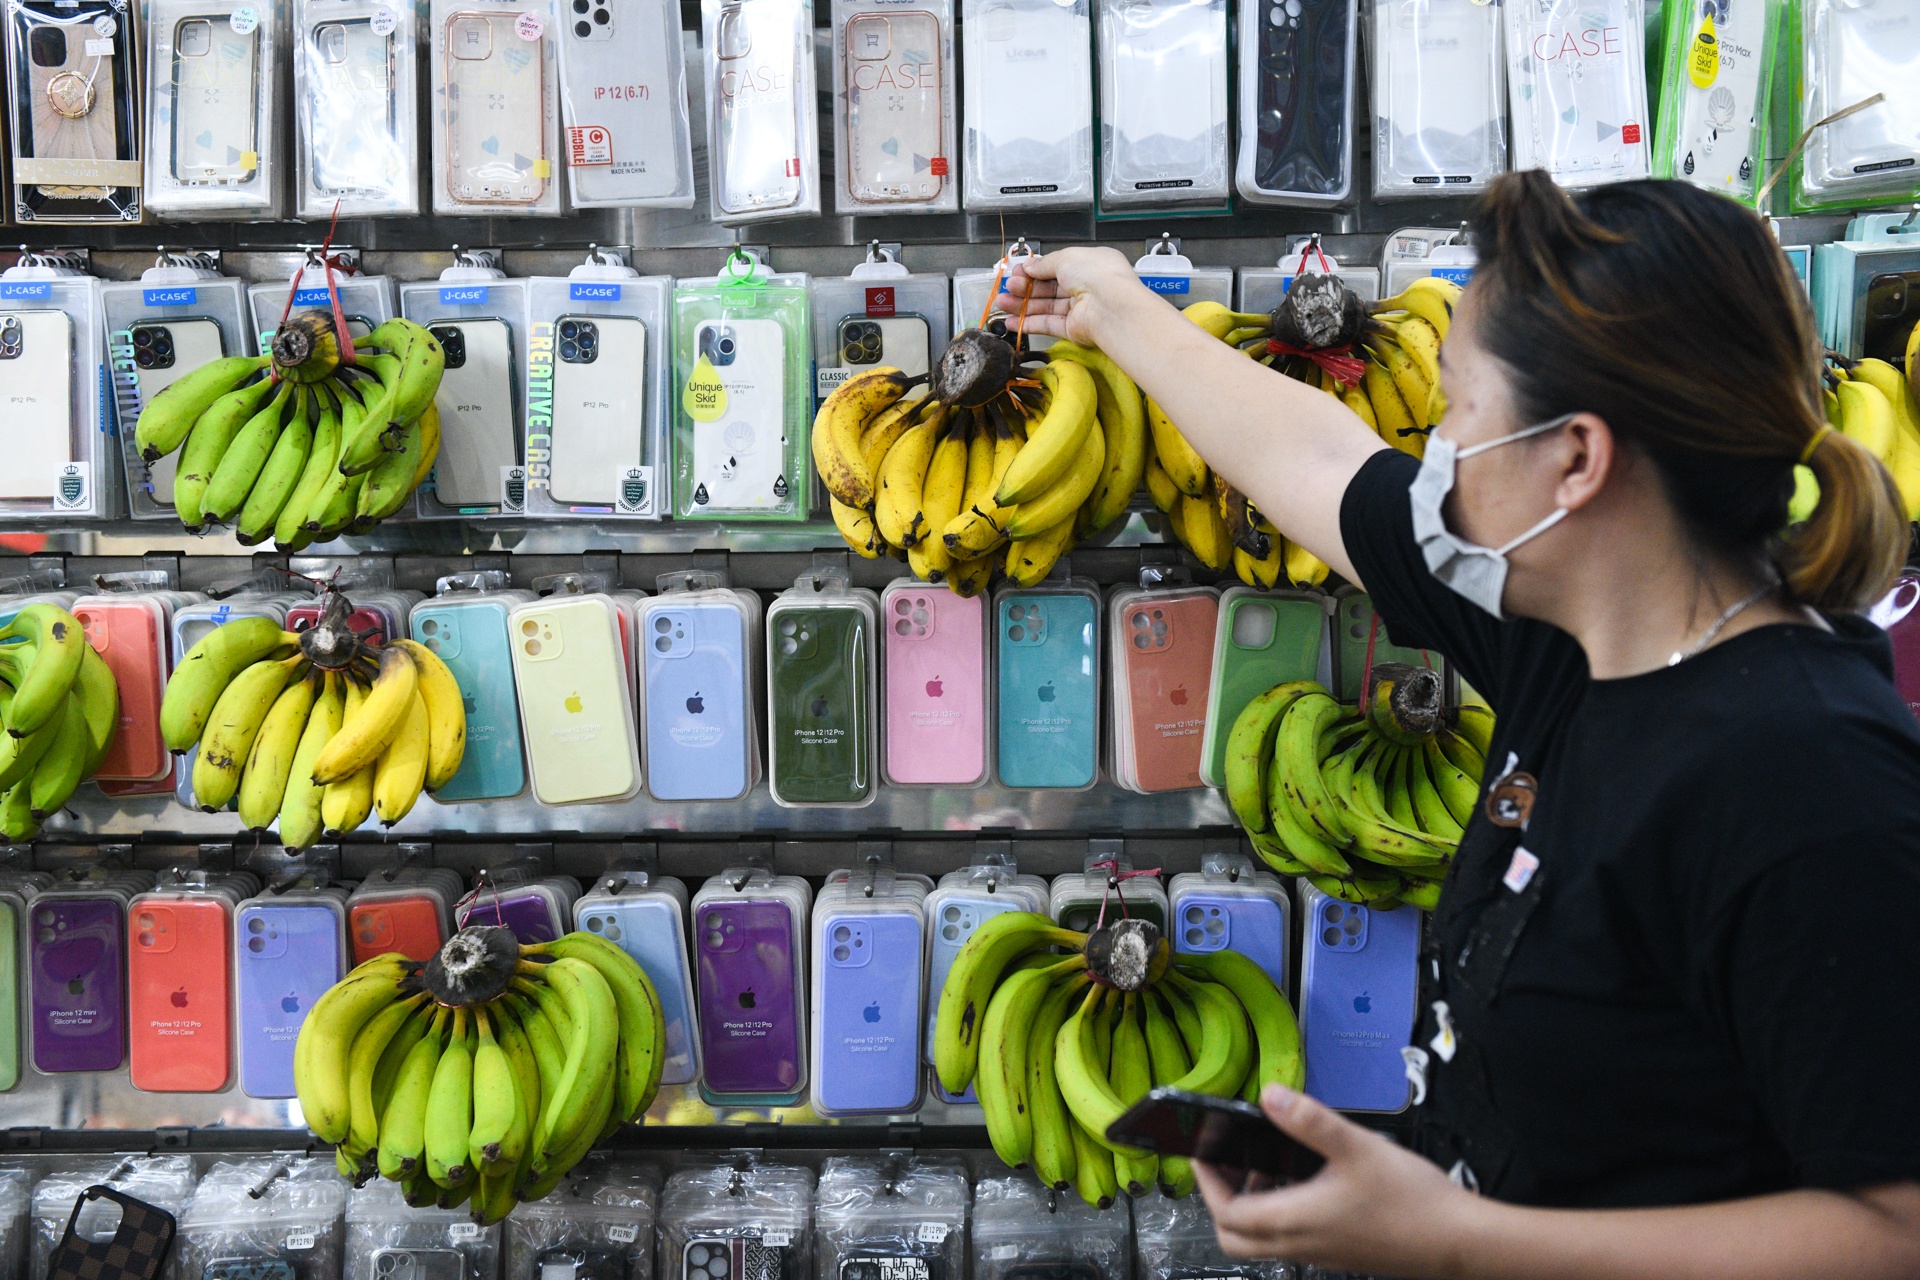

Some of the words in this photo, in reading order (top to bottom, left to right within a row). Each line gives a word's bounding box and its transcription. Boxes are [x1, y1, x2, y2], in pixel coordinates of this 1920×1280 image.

[1533, 27, 1621, 61] CASE
[1693, 42, 1718, 59] Unique
[1721, 41, 1734, 53] Pro
[1735, 46, 1752, 58] Max
[1697, 55, 1712, 69] Skid
[721, 65, 786, 98] CASE
[853, 63, 934, 91] CASE
[608, 86, 622, 99] 12
[624, 85, 649, 101] (6.7)
[572, 129, 585, 163] MOBILE
[1857, 164, 1879, 172] Protective
[528, 321, 554, 427] CREATIVE
[820, 372, 849, 381] CLASSIC
[689, 382, 723, 393] Unique
[695, 393, 716, 403] Skid
[527, 434, 551, 490] CASE
[617, 1229, 622, 1237] 12
[623, 1230, 632, 1239] PRO
[923, 1225, 928, 1233] IP
[929, 1226, 935, 1234] 12
[935, 1226, 946, 1234] PRO
[304, 1237, 313, 1245] PRO
